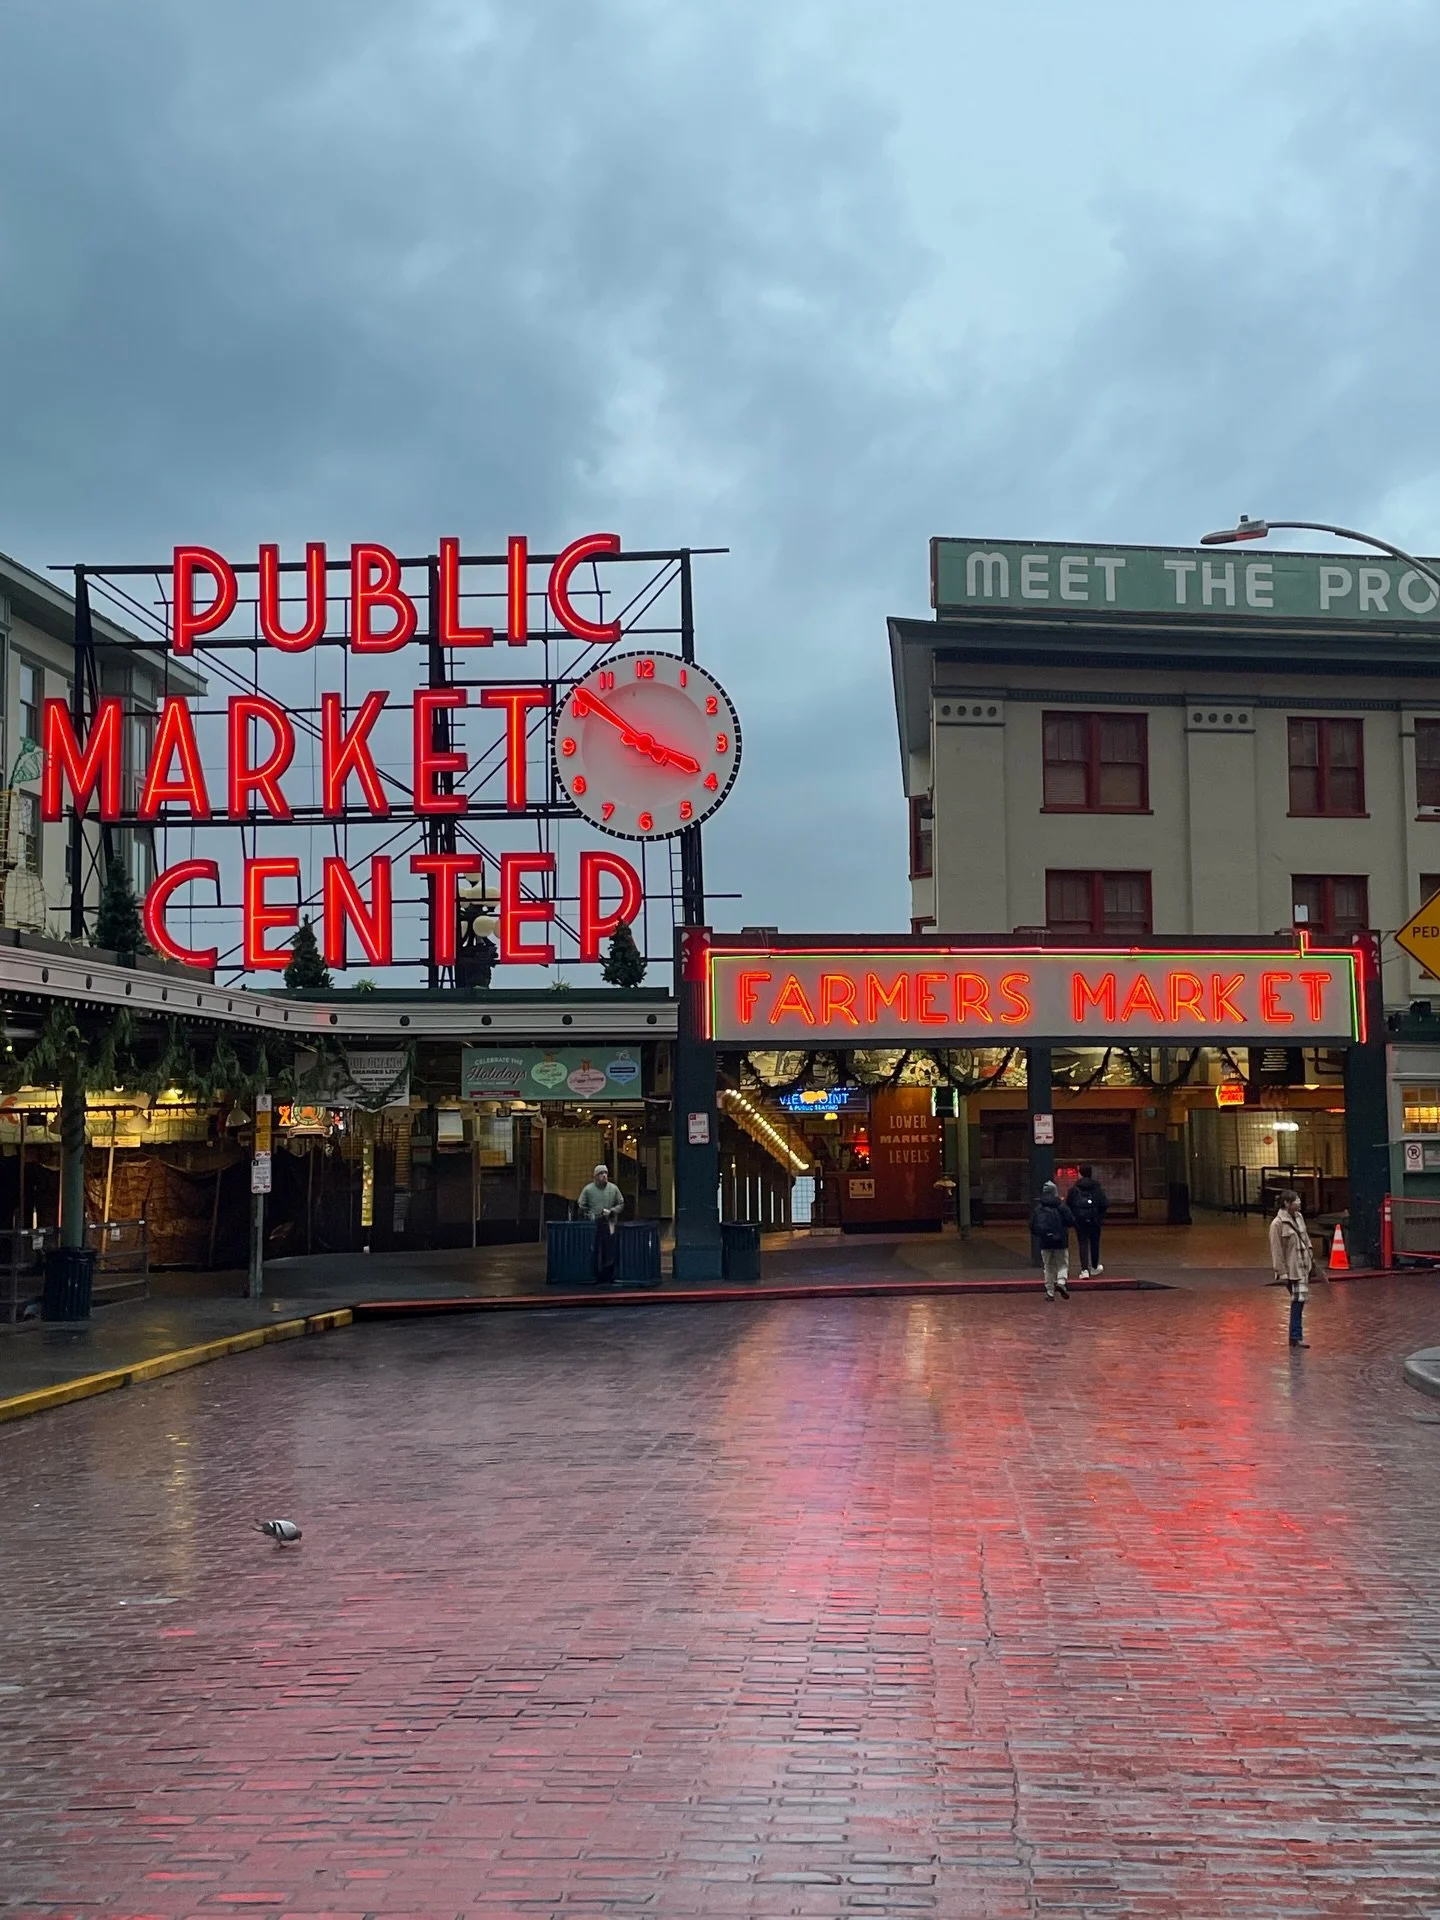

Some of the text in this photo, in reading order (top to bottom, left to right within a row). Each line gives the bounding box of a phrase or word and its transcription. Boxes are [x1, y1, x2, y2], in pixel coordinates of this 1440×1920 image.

[965, 551, 1440, 614] MEET THE PRO
[172, 533, 622, 656] PUBLIC
[635, 659, 655, 679] 12
[679, 669, 687, 688] 1
[599, 671, 615, 690] 11
[705, 696, 718, 715] 2
[561, 737, 576, 756] 9
[715, 733, 728, 753] 3
[41, 687, 556, 823] MARKET
[572, 775, 587, 795] 8
[703, 772, 718, 791] 4
[601, 802, 615, 821] 7
[679, 800, 693, 819] 5
[638, 811, 653, 831] 6
[1412, 926, 1440, 938] PED
[738, 971, 1332, 1025] FARMERS MARKET
[474, 1057, 524, 1066] CELEBRATE THE
[466, 1066, 527, 1086] Holidays
[890, 1115, 927, 1129] LOWER
[880, 1134, 938, 1144] MARKET
[889, 1150, 930, 1164] LEVELS
